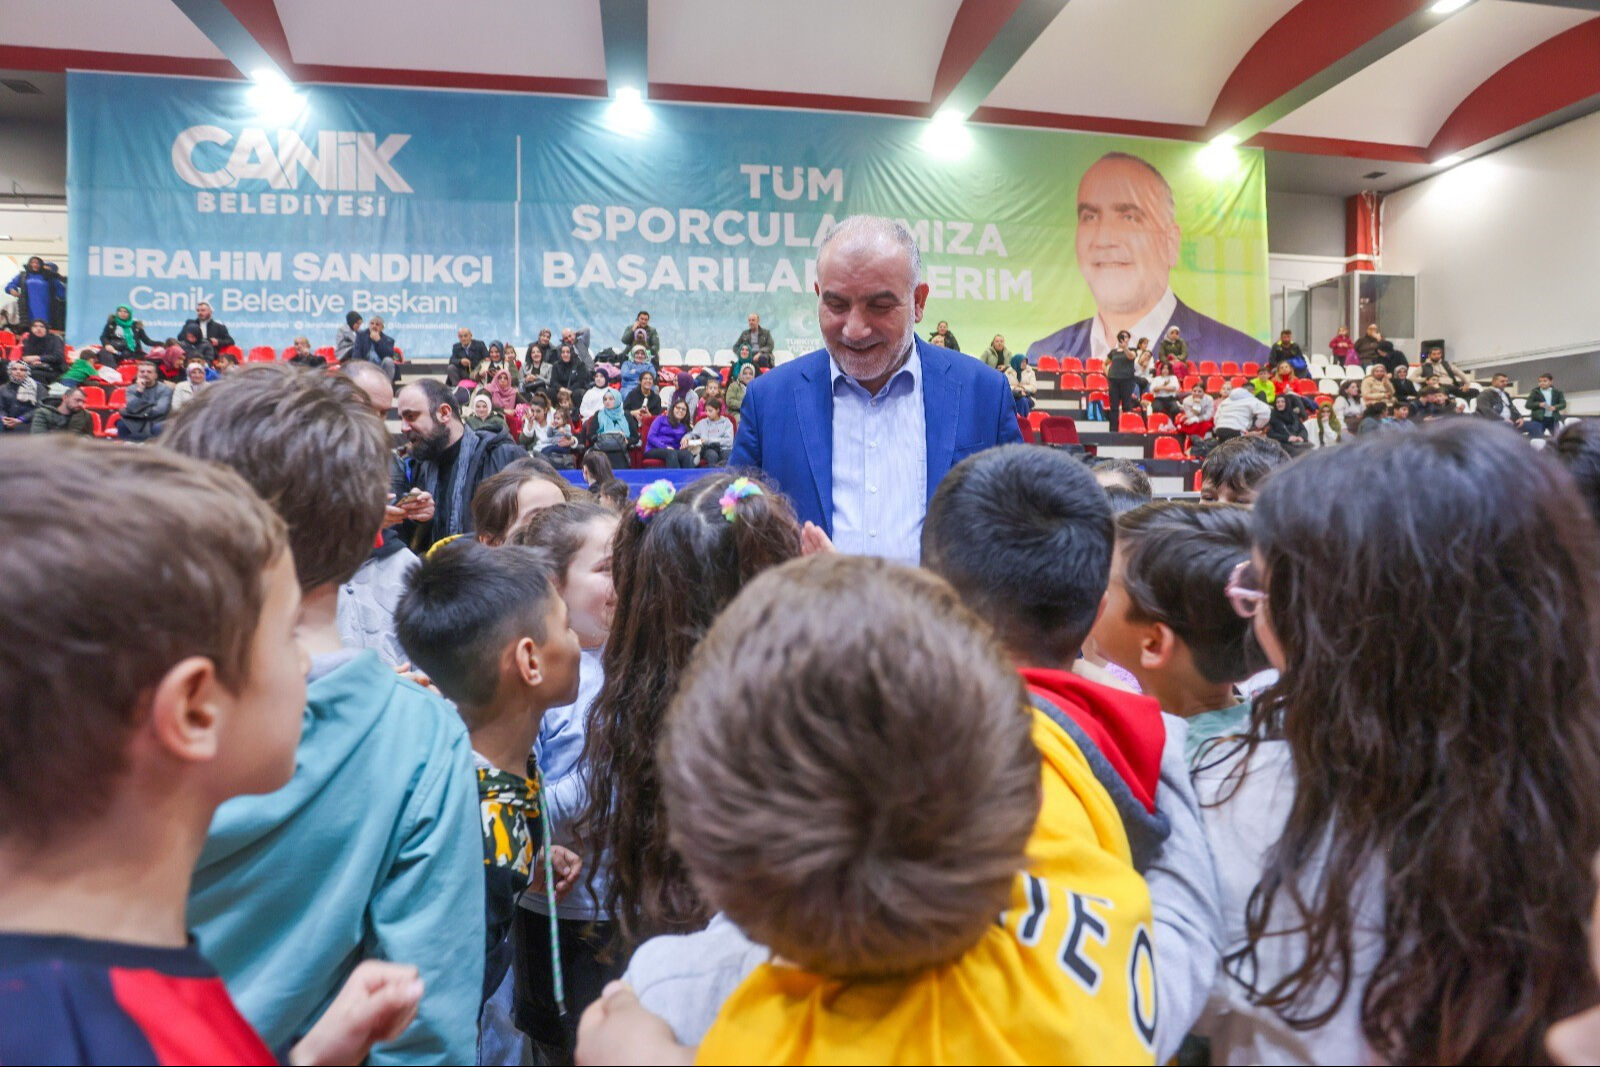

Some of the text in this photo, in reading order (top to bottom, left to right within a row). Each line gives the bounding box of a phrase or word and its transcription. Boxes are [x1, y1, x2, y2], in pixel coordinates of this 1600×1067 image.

[740, 164, 844, 202] TÜM
[197, 192, 387, 217] BELEDİYESİ
[571, 205, 1008, 257] SPORCULAMIZA
[293, 252, 494, 288] SANDIKÇI
[927, 265, 1033, 302] ERİM
[129, 286, 458, 317] Canik Belediye Başkanı
